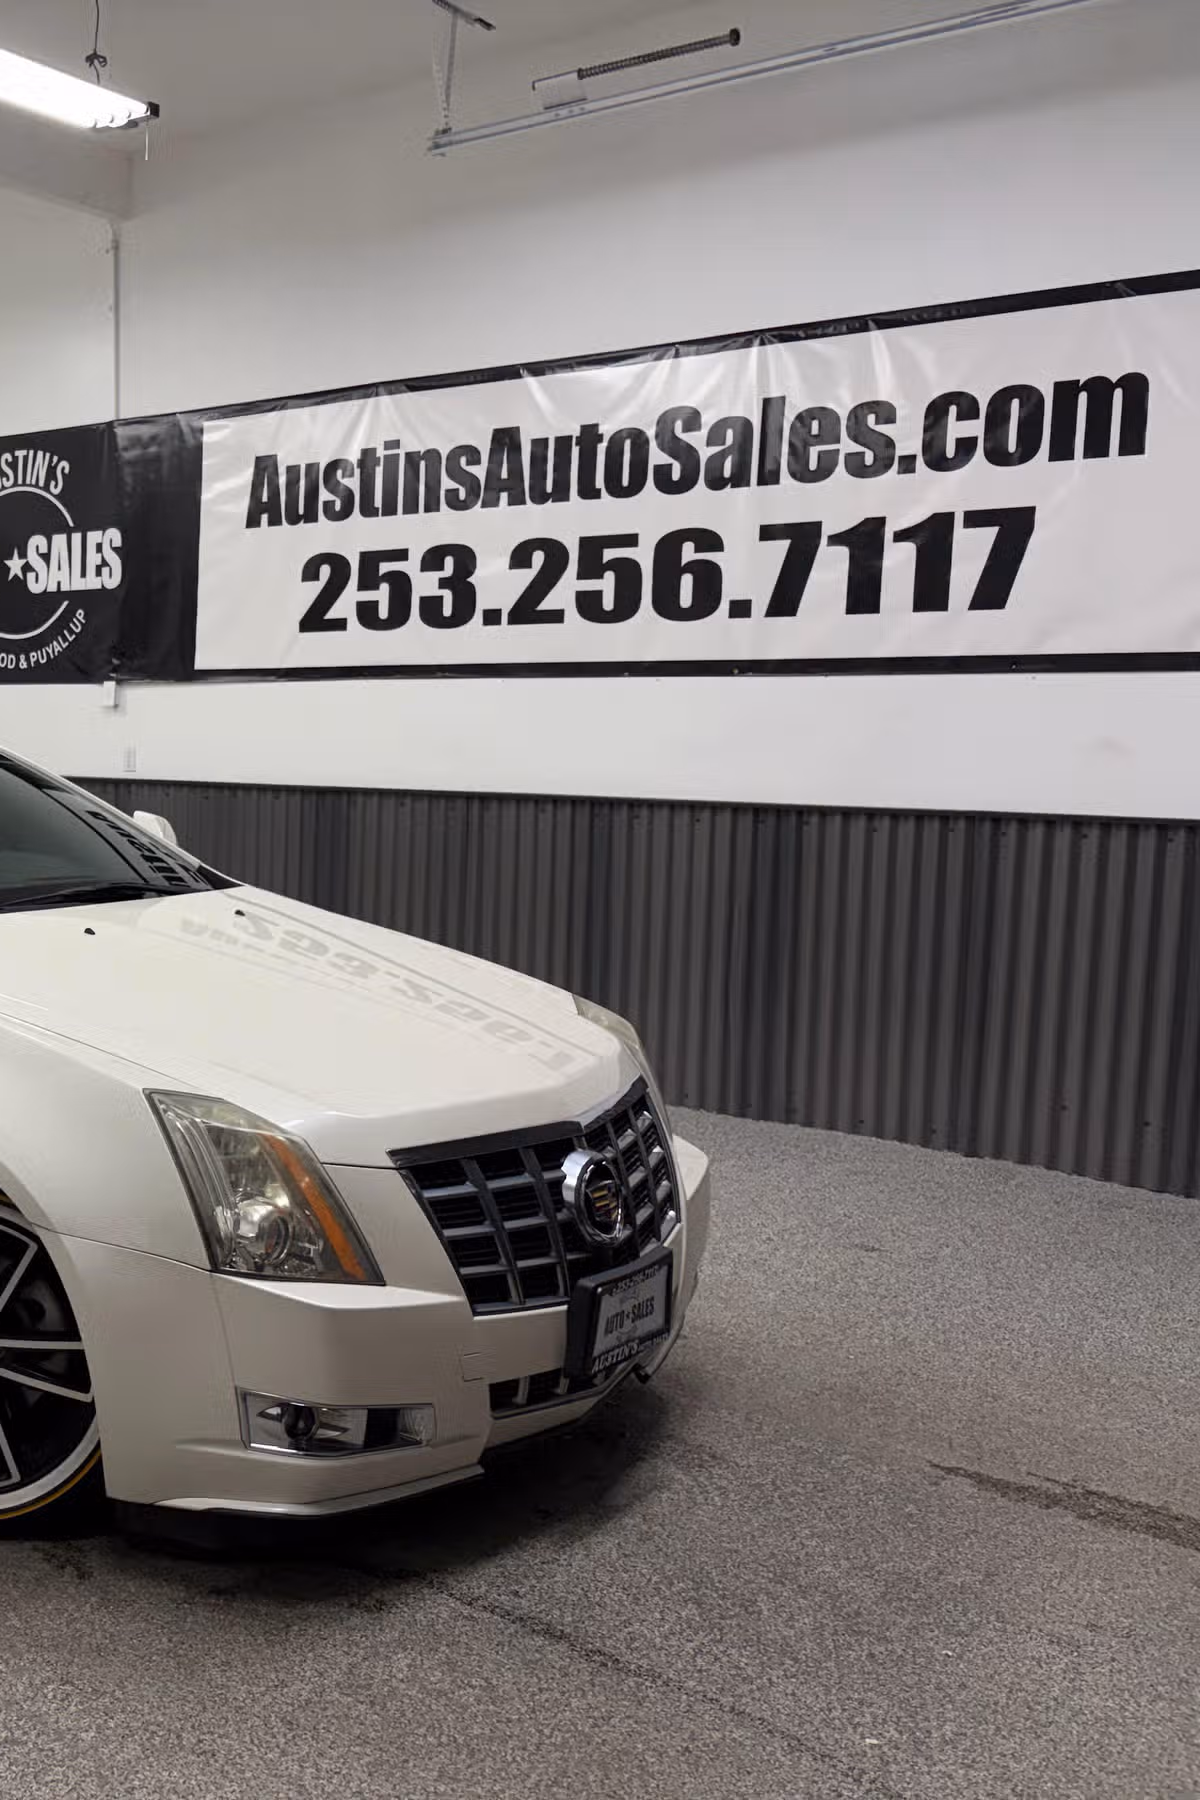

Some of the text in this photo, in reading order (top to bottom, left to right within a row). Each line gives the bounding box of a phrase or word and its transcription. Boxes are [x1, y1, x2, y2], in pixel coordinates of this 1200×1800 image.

[245, 371, 1150, 529] AustinsAutoSales.com
[26, 527, 122, 594] SALES
[298, 505, 1037, 634] 253.256.7117
[19, 654, 28, 669] &
[29, 608, 86, 668] PUYALLUP
[605, 1310, 625, 1335] AUTO
[632, 1297, 655, 1323] SALES
